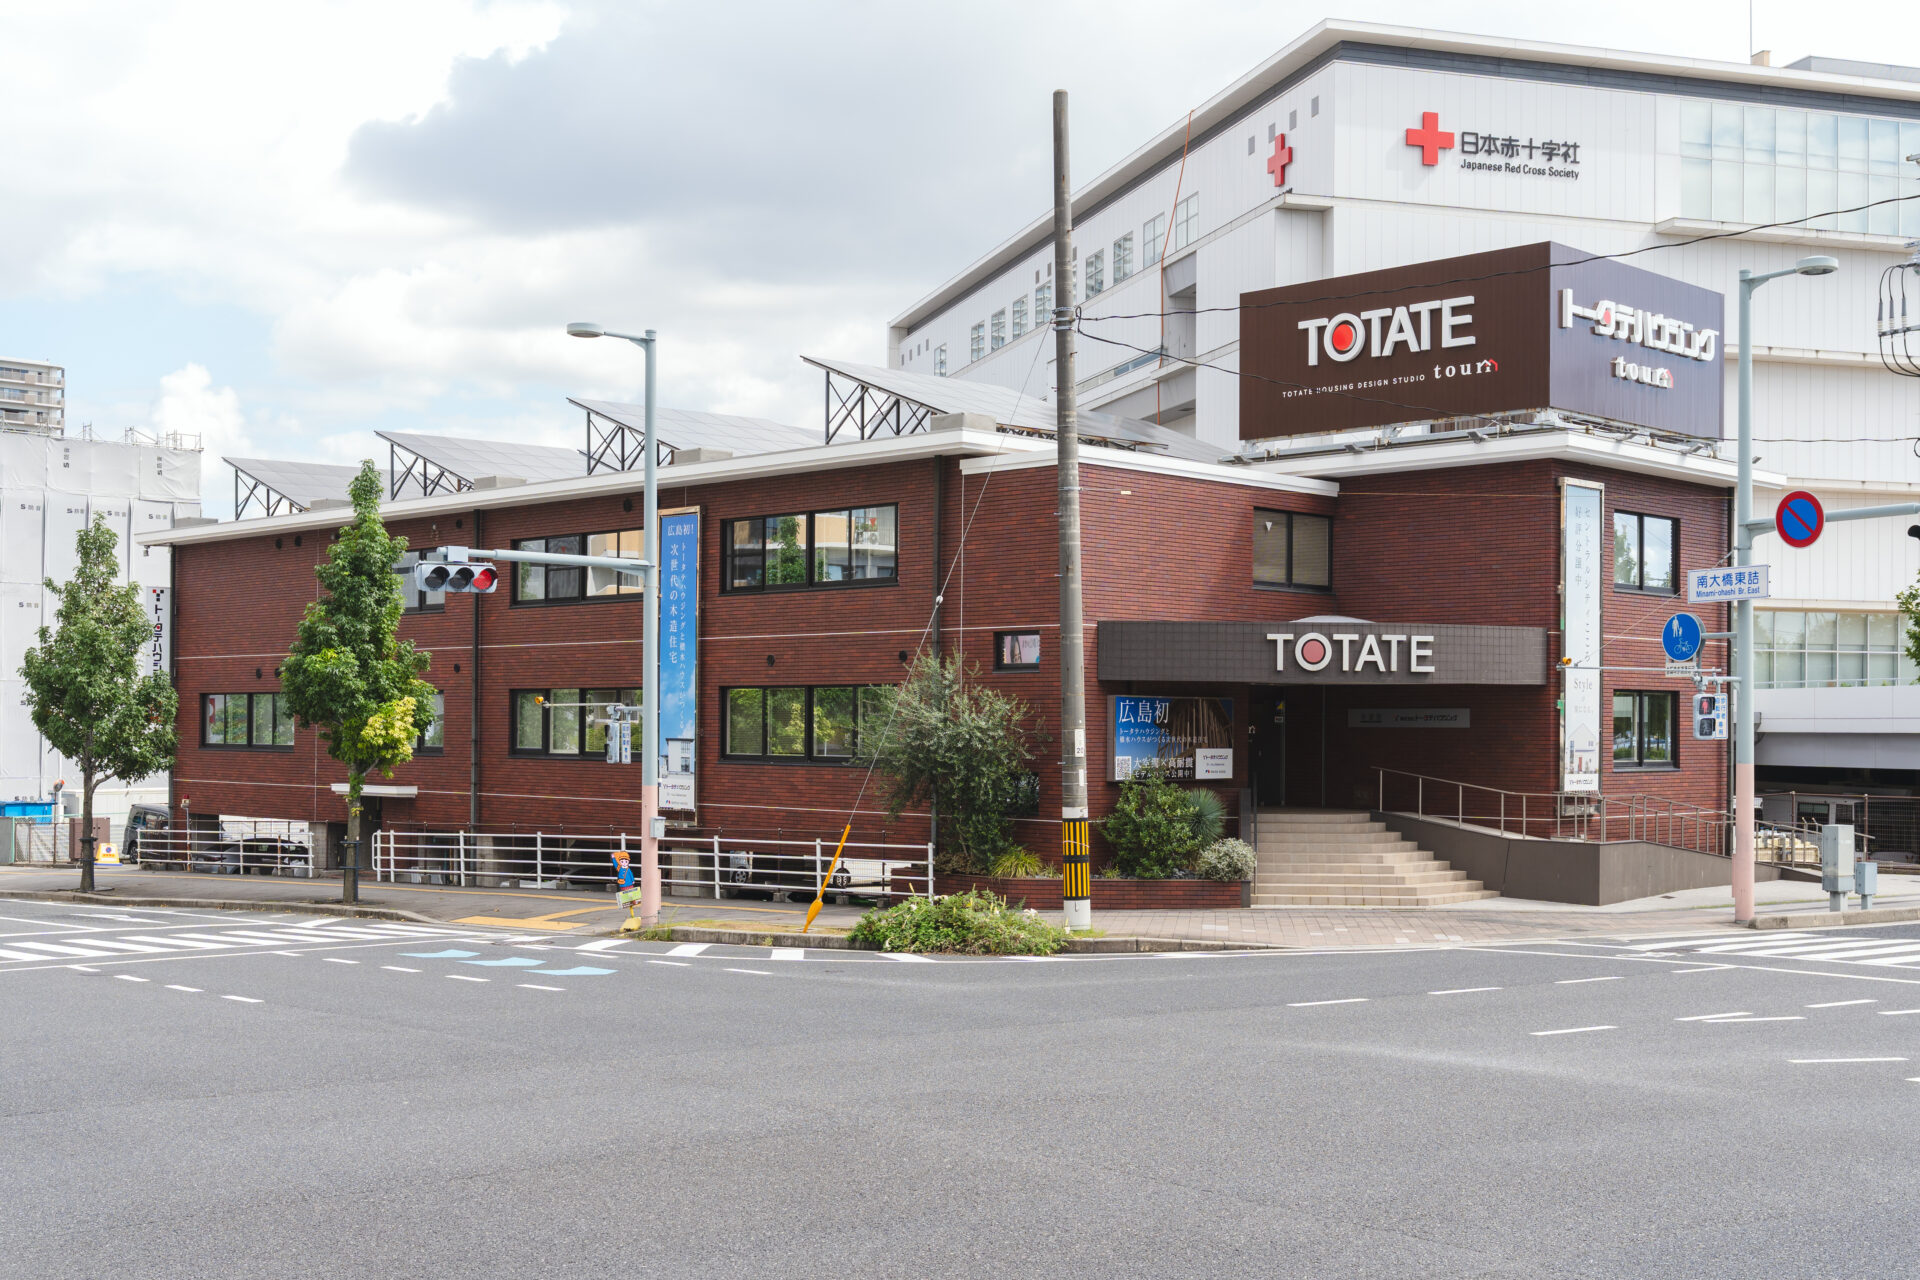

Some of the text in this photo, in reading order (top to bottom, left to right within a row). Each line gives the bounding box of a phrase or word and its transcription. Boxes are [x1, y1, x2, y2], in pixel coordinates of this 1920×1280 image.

[1461, 131, 1580, 164] 日本赤十字社
[1461, 159, 1579, 180] Japanese Red Cross Society
[1298, 295, 1476, 366] TOTATE
[1562, 287, 1719, 362] トータテハウジング
[1282, 388, 1313, 398] TOTATE
[1357, 379, 1389, 389] DESIGN
[1392, 374, 1426, 384] STUDIO
[1696, 570, 1760, 589] 南大橋東詰
[1696, 588, 1736, 598] Minami-ohashi
[1747, 586, 1760, 594] East
[669, 543, 679, 664] 次世代の木造住宅
[1266, 632, 1436, 673] TOTATE
[1118, 700, 1169, 724] 広島初
